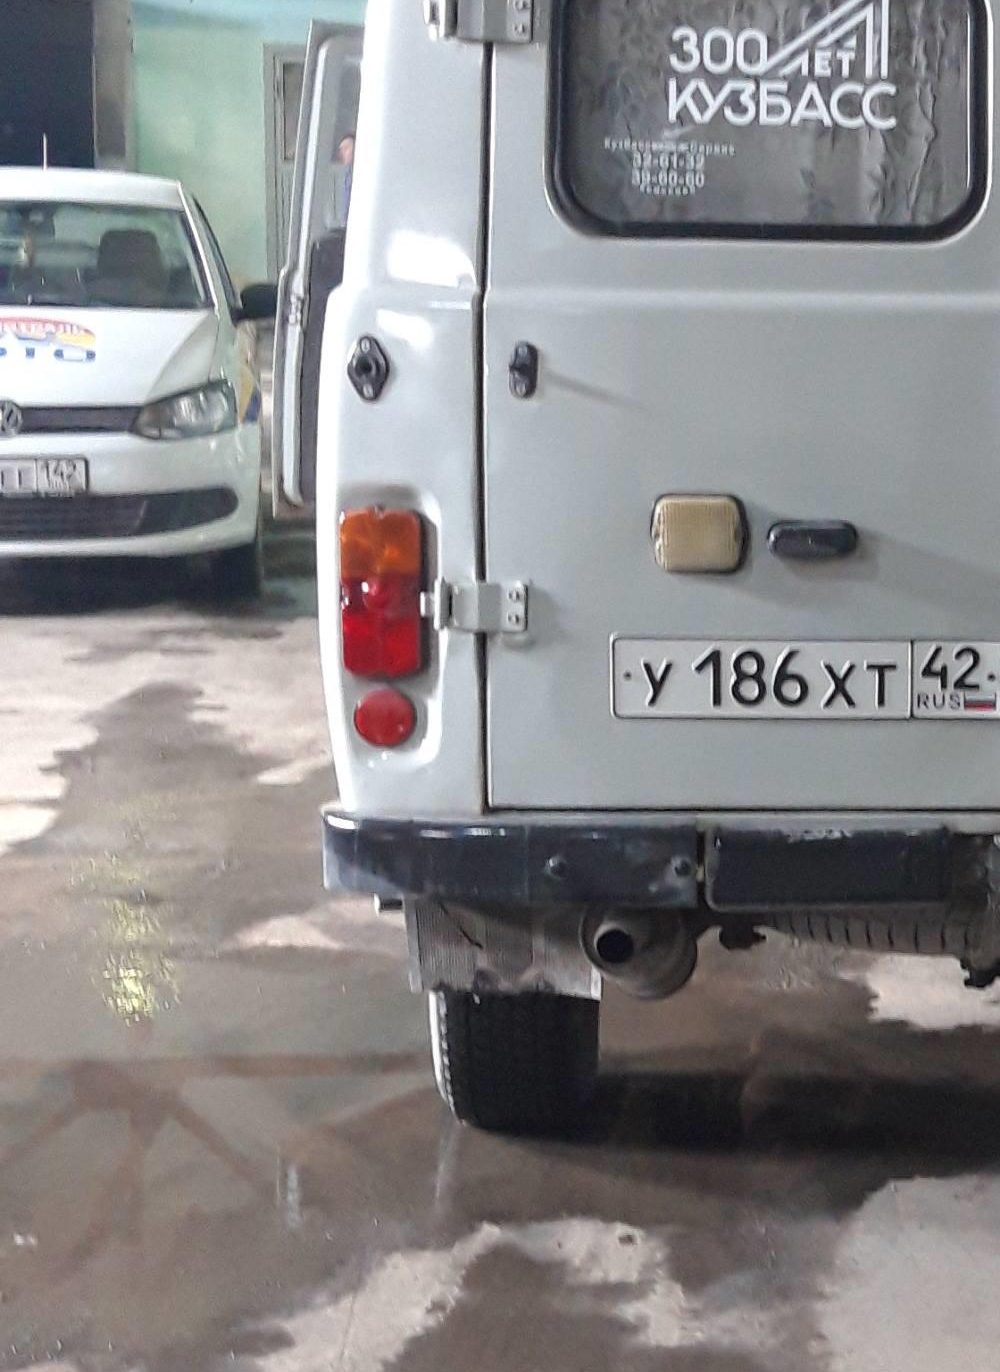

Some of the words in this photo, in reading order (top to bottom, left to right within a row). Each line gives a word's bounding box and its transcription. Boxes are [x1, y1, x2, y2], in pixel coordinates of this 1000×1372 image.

[668, 26, 769, 75] 300
[667, 76, 897, 129] КУЗБАСС
[920, 643, 982, 692] 42
[916, 692, 962, 711] RUS
